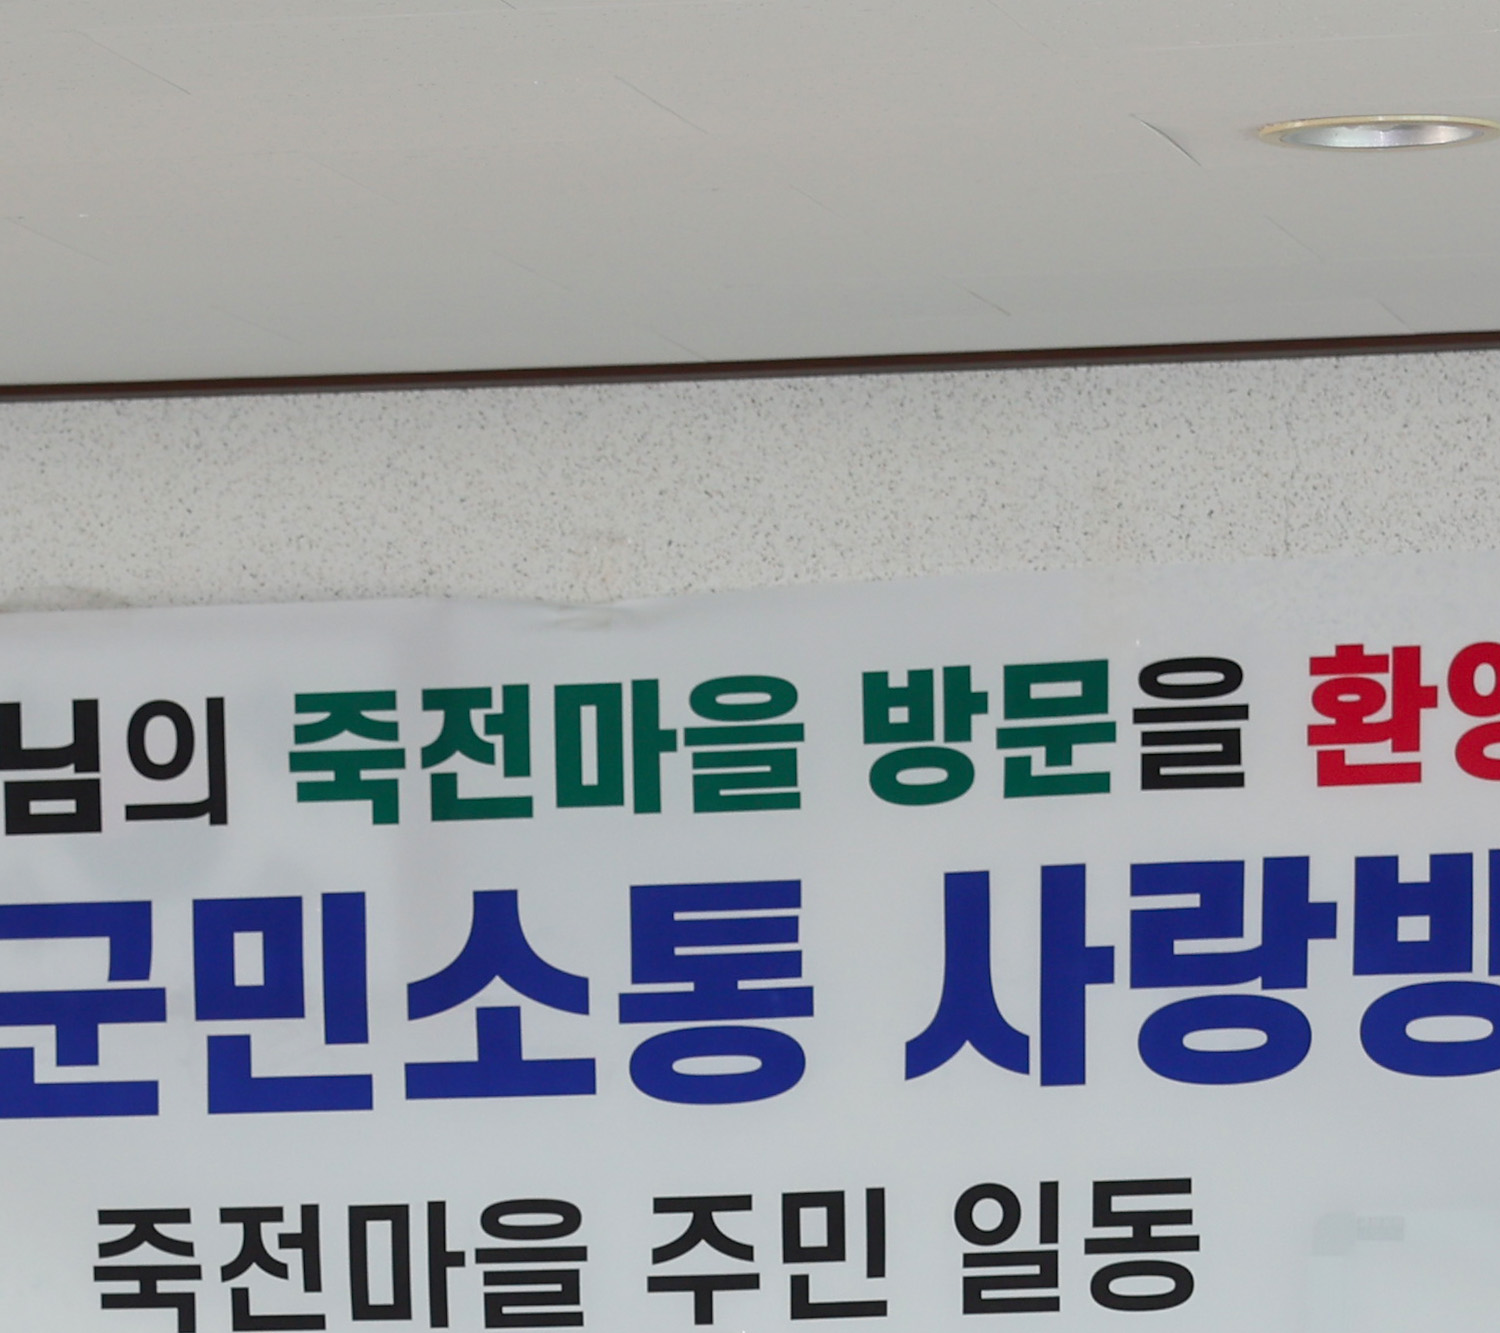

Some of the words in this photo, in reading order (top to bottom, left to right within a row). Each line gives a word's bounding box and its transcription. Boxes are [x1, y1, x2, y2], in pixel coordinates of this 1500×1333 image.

[288, 675, 805, 825] 죽전마을
[862, 656, 1250, 806] 방문을
[645, 1187, 888, 1325] 주민
[953, 1177, 1200, 1315] 일동
